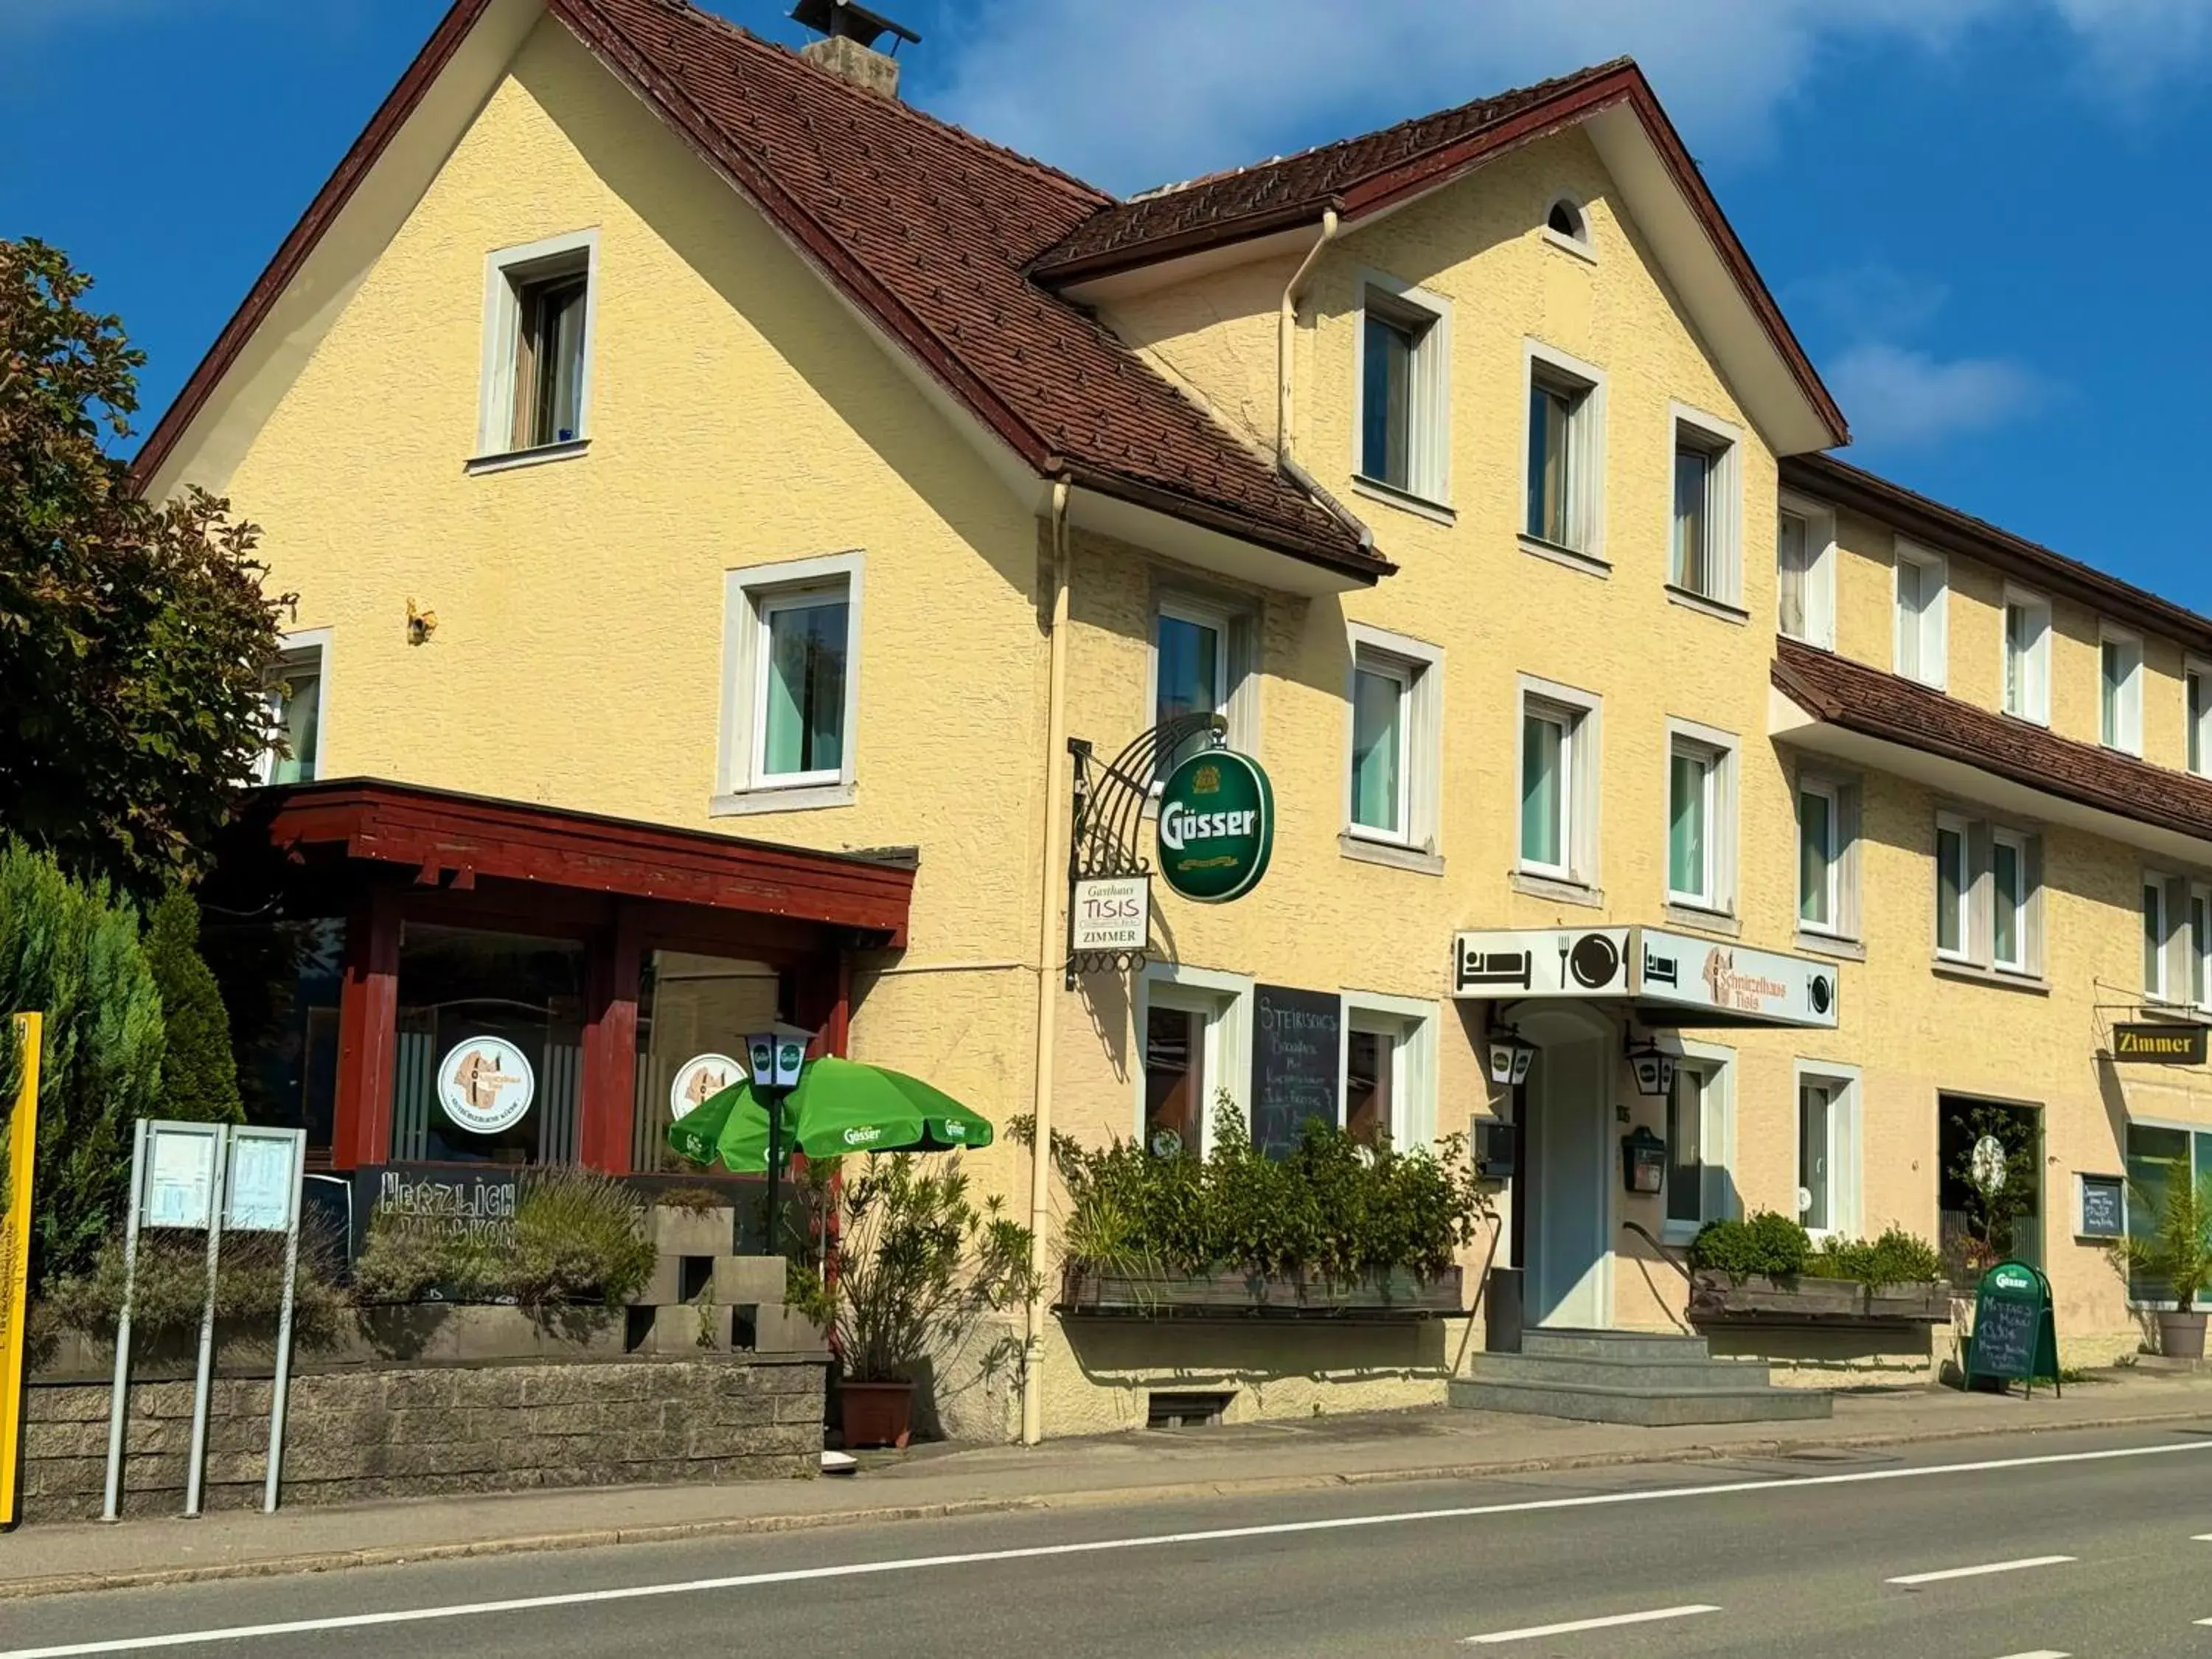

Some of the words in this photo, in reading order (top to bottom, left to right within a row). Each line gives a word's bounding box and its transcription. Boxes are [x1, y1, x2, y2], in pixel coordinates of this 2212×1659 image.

[1160, 800, 1256, 850] Gösser
[1082, 899, 1139, 918] TISIS
[1083, 931, 1135, 943] ZIMMER
[2119, 1032, 2193, 1053] Zimmer
[844, 1127, 882, 1144] Gösser
[380, 1172, 516, 1217] HERZLICH
